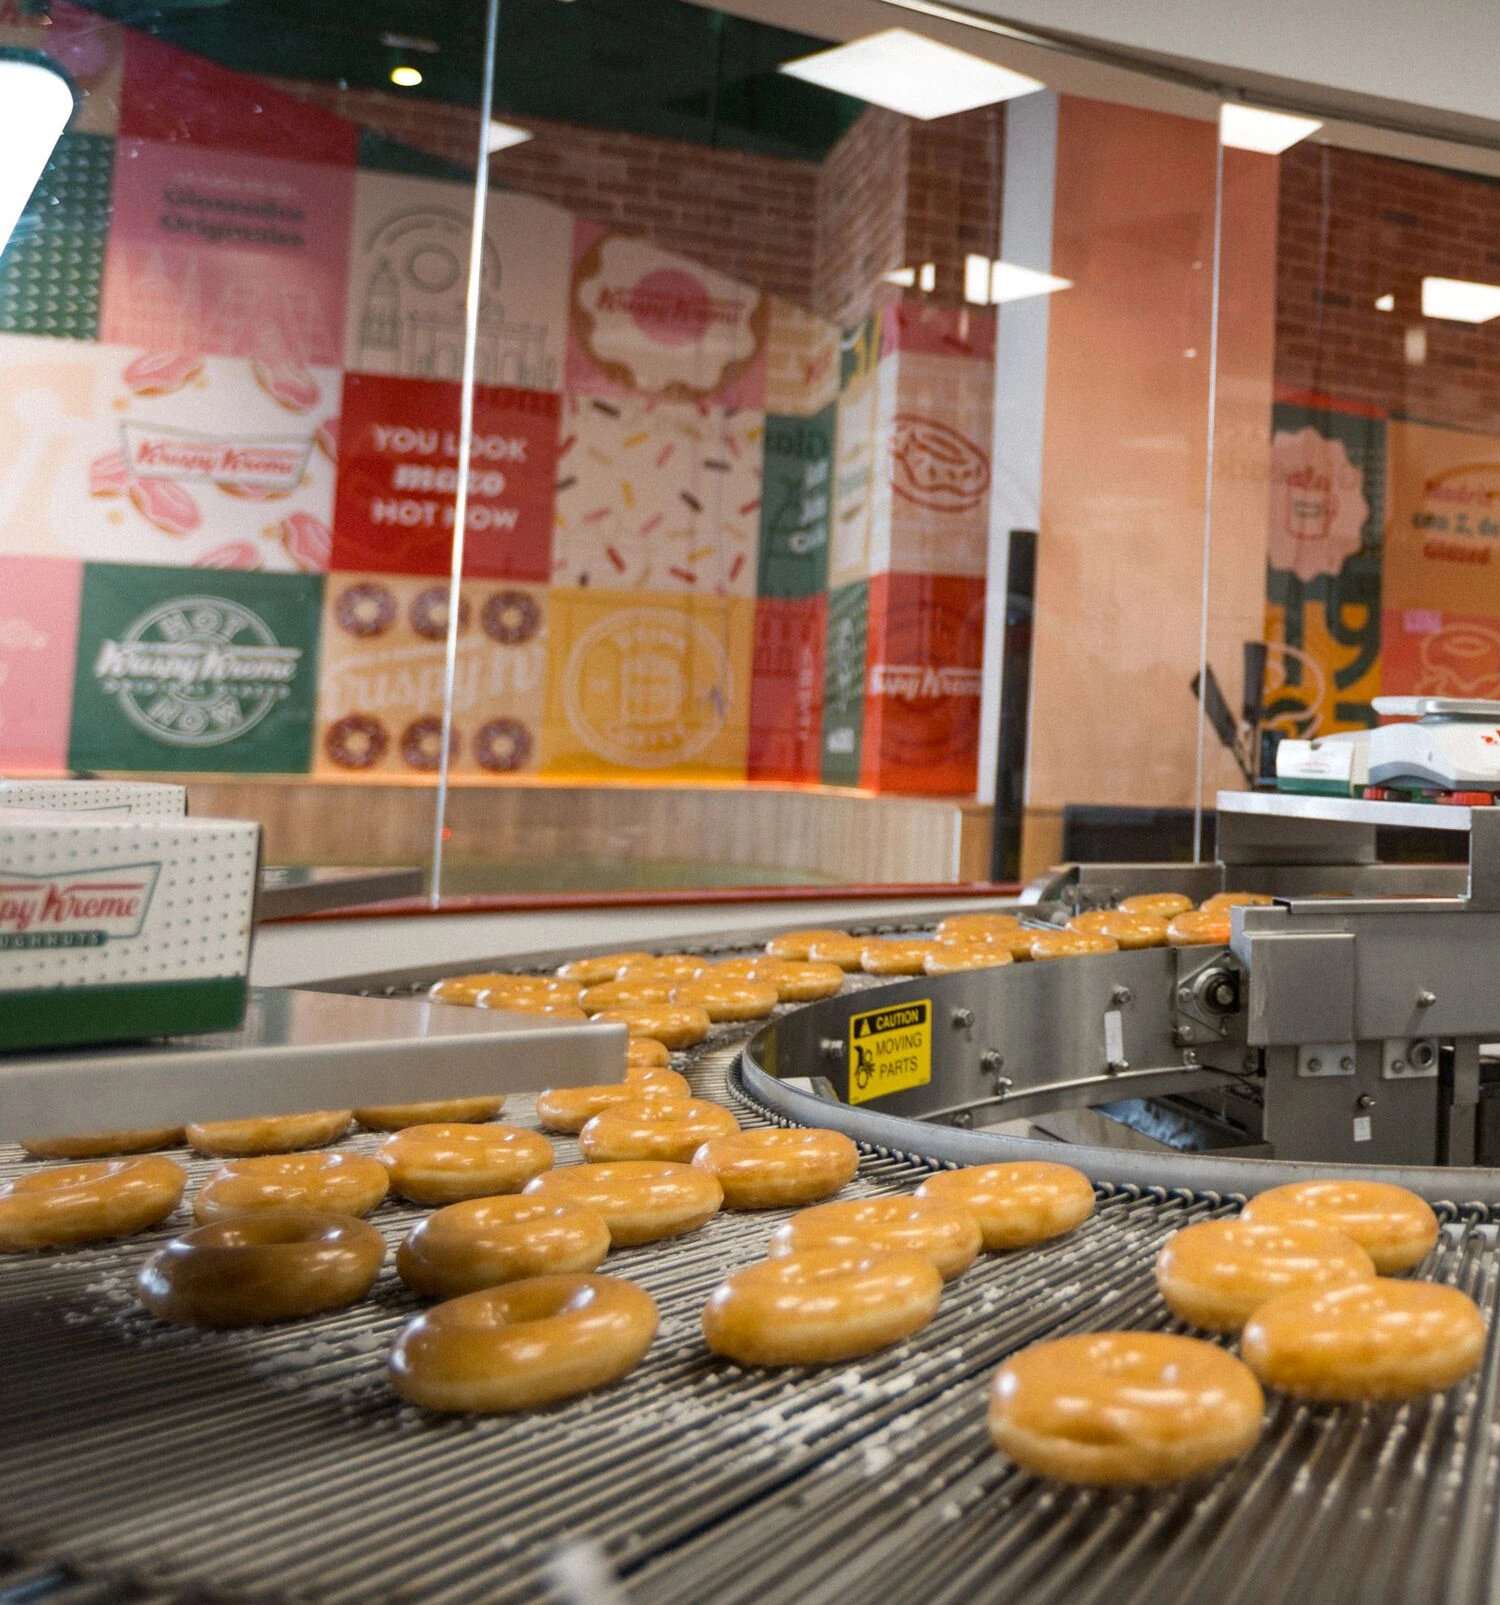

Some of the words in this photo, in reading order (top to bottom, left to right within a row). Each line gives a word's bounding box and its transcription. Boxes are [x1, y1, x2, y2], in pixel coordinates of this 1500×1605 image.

[370, 423, 440, 455] YOU
[370, 499, 438, 527] HOT
[155, 607, 248, 641] HOT
[150, 696, 243, 734] NOW
[40, 882, 145, 923] Kreme
[875, 1007, 920, 1031] CAUTION
[875, 1031, 922, 1057] MOVING
[880, 1055, 918, 1079] PARTS
